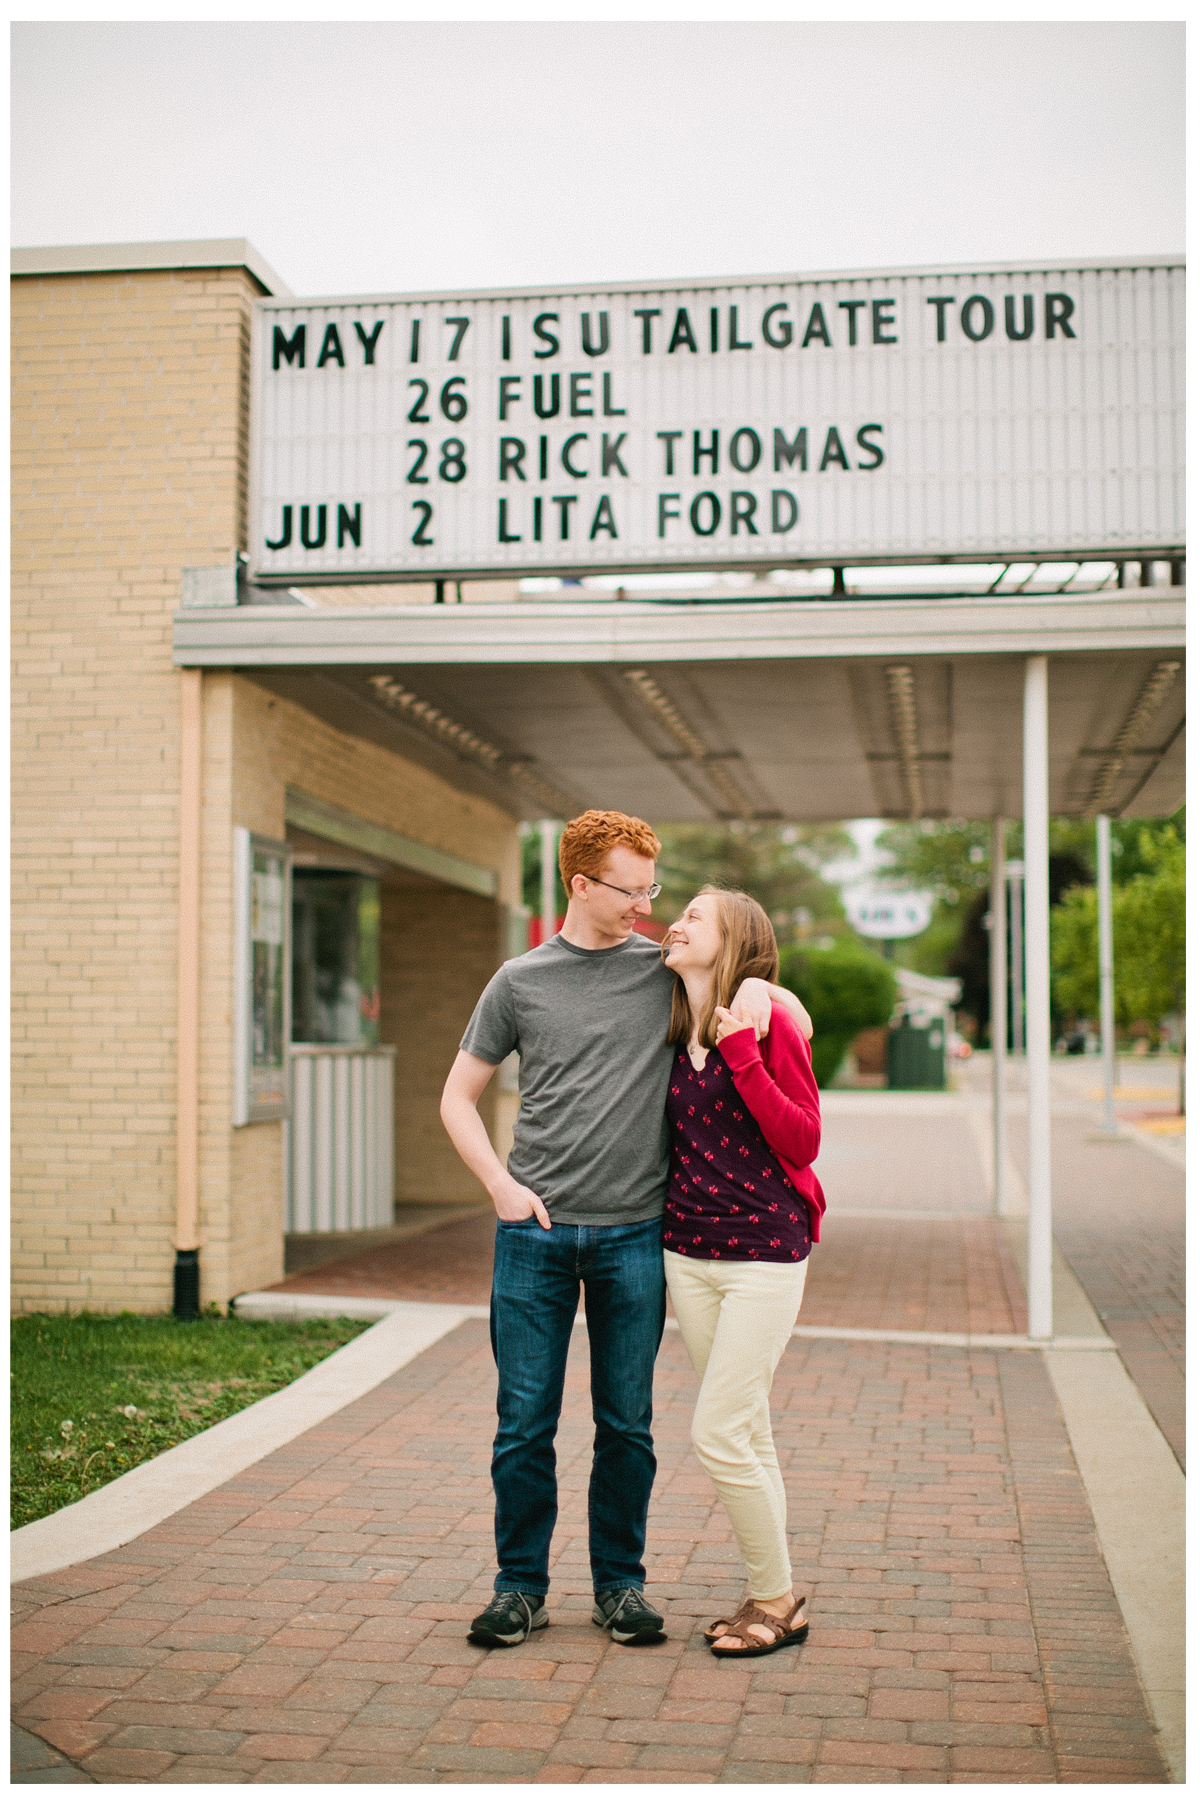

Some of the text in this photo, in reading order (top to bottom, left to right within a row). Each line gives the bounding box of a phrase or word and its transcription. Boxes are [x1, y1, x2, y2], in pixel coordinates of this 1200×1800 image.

[270, 320, 386, 373] MAY
[409, 316, 471, 364] 17
[633, 298, 899, 357] TAILGATE
[926, 292, 1078, 344] TOUR
[406, 371, 628, 425] 26 FUEL
[405, 423, 886, 486] 28 RICK THOMAS
[265, 489, 800, 547] JUN 2 LITA FORD
